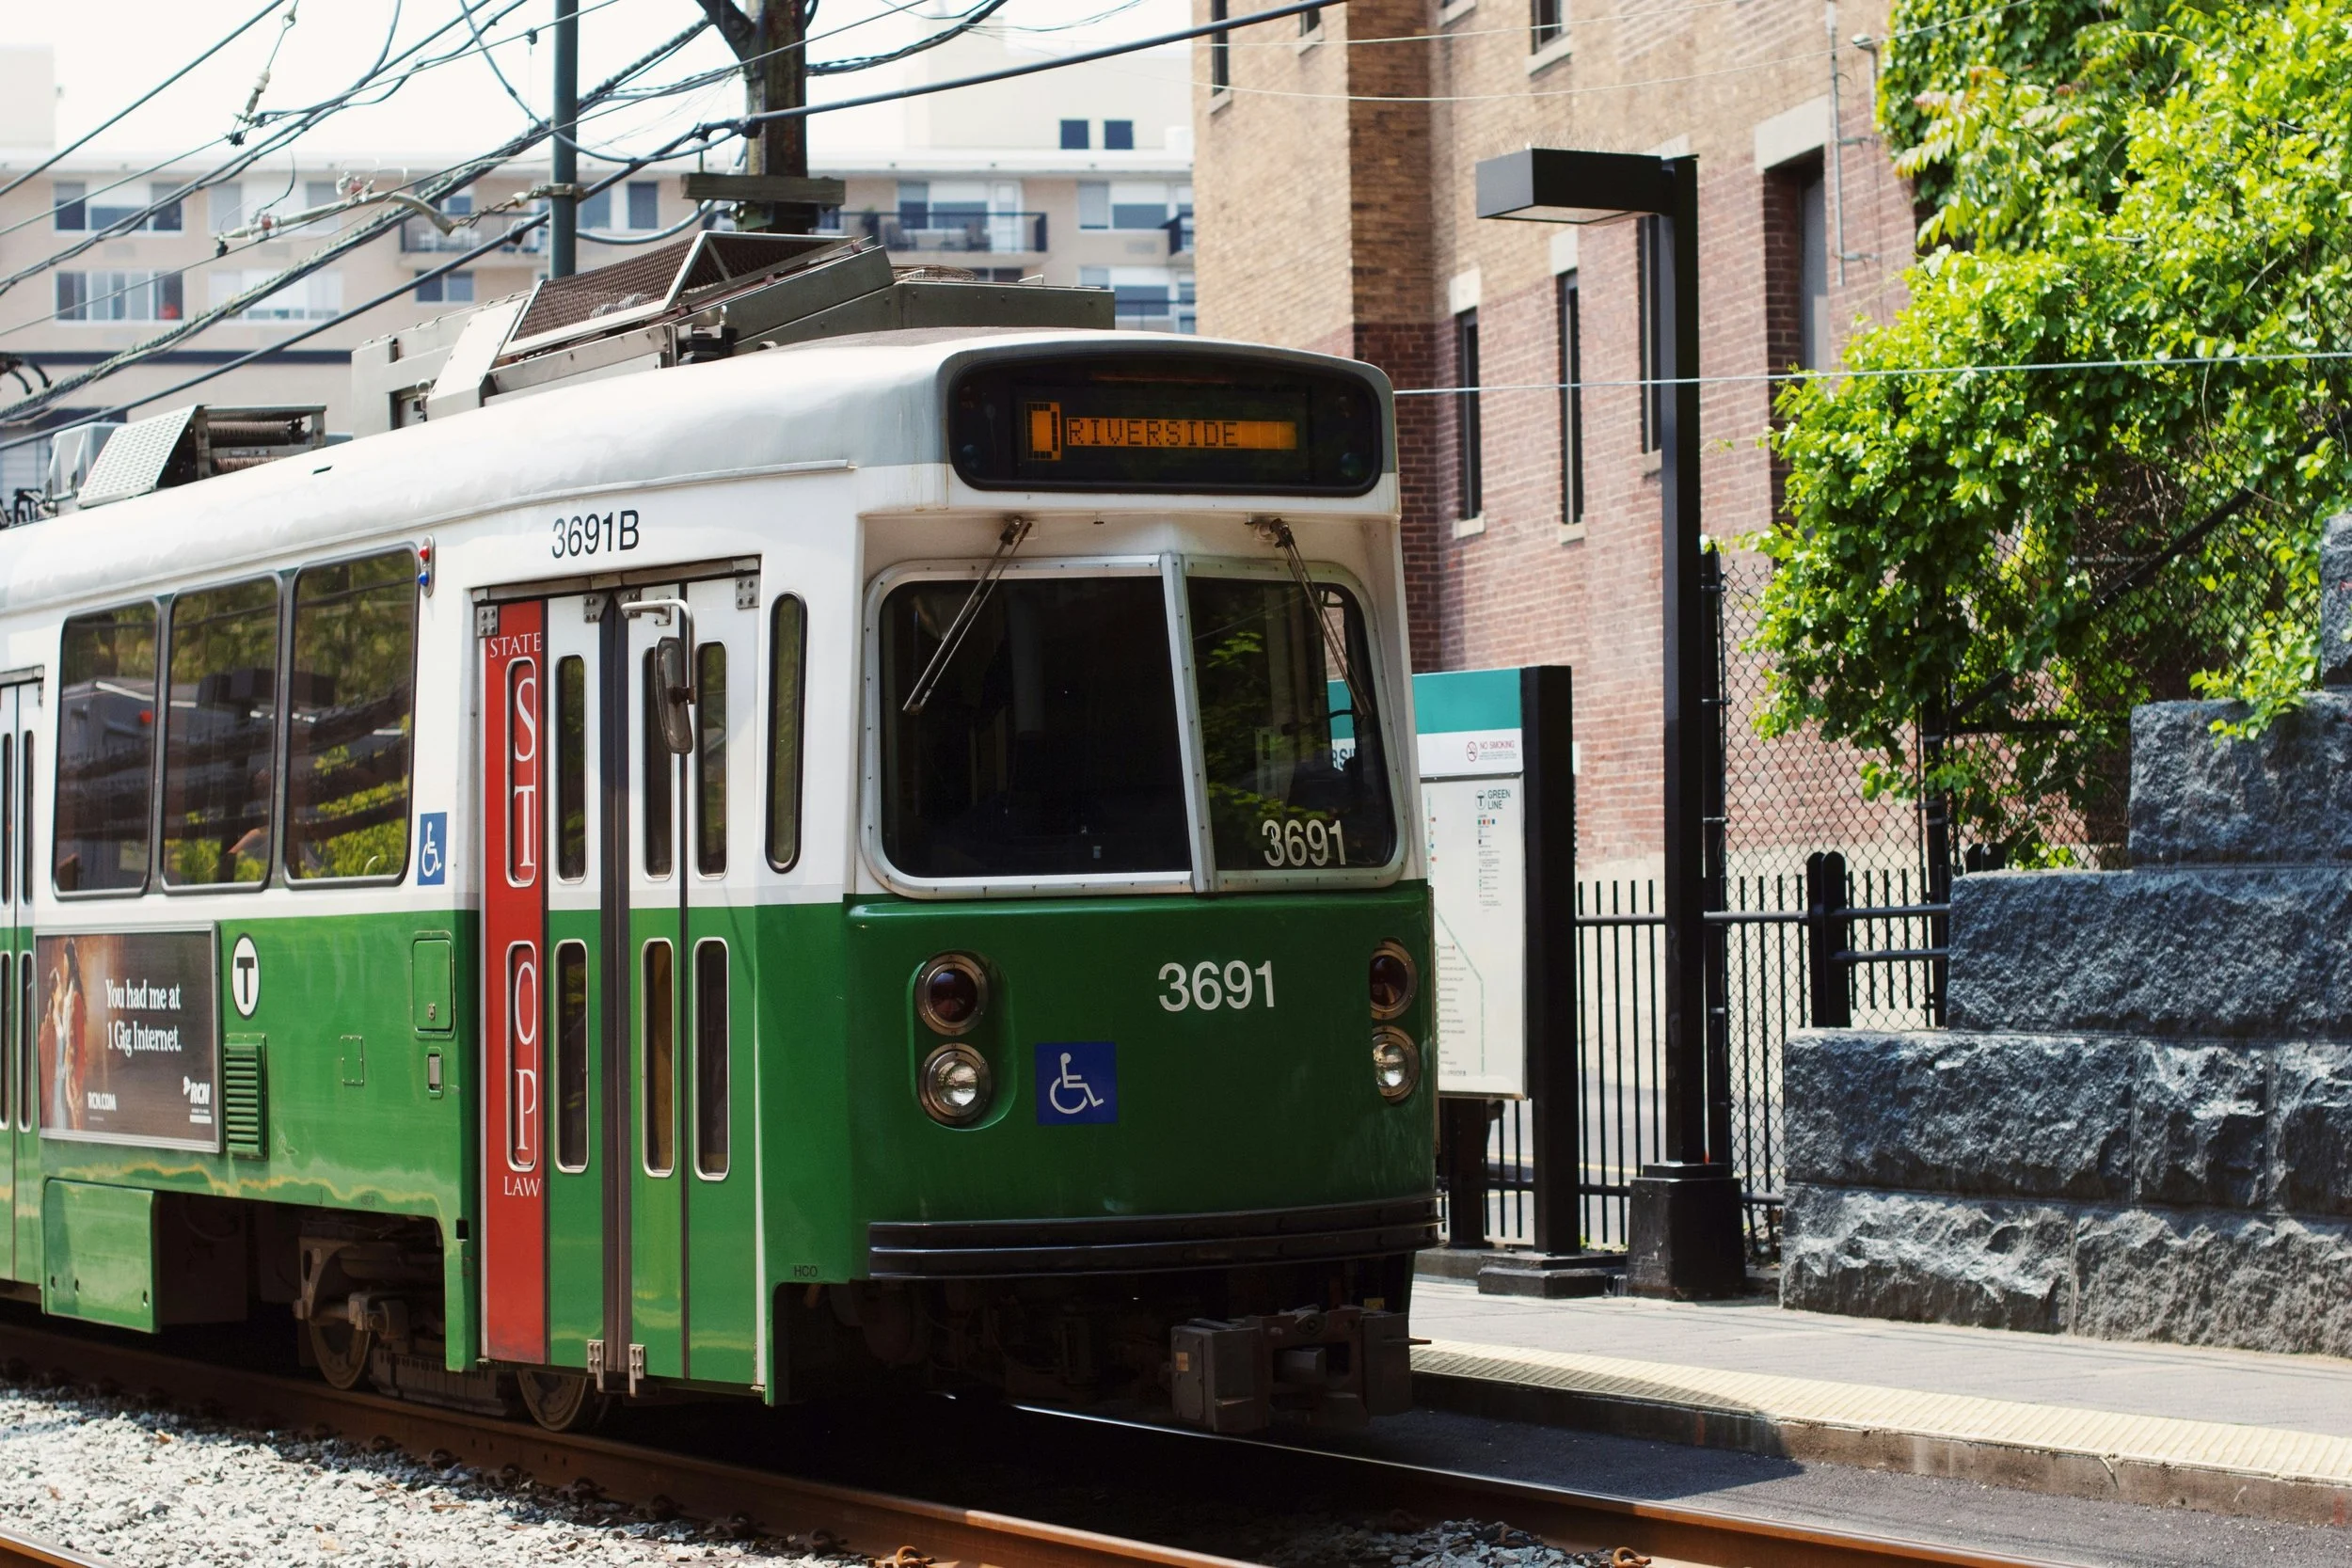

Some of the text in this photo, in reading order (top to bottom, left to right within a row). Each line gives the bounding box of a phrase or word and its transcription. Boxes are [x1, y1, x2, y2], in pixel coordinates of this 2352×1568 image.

[1067, 418, 1239, 447] RIVERSIDE
[551, 509, 640, 559] 3691B
[489, 632, 542, 658] STATE
[1480, 740, 1515, 750] NO SMOKING
[1487, 788, 1511, 800] GREEN
[1487, 800, 1503, 810] LINE
[1262, 819, 1346, 867] 3691
[105, 978, 181, 1010] You had me at
[236, 957, 254, 1006] T
[1158, 959, 1275, 1012] 3691
[107, 1020, 182, 1057] 1 Gig Internet.
[190, 1082, 210, 1105] RCN
[503, 1176, 541, 1197] LAW
[793, 1264, 818, 1277] HCO
